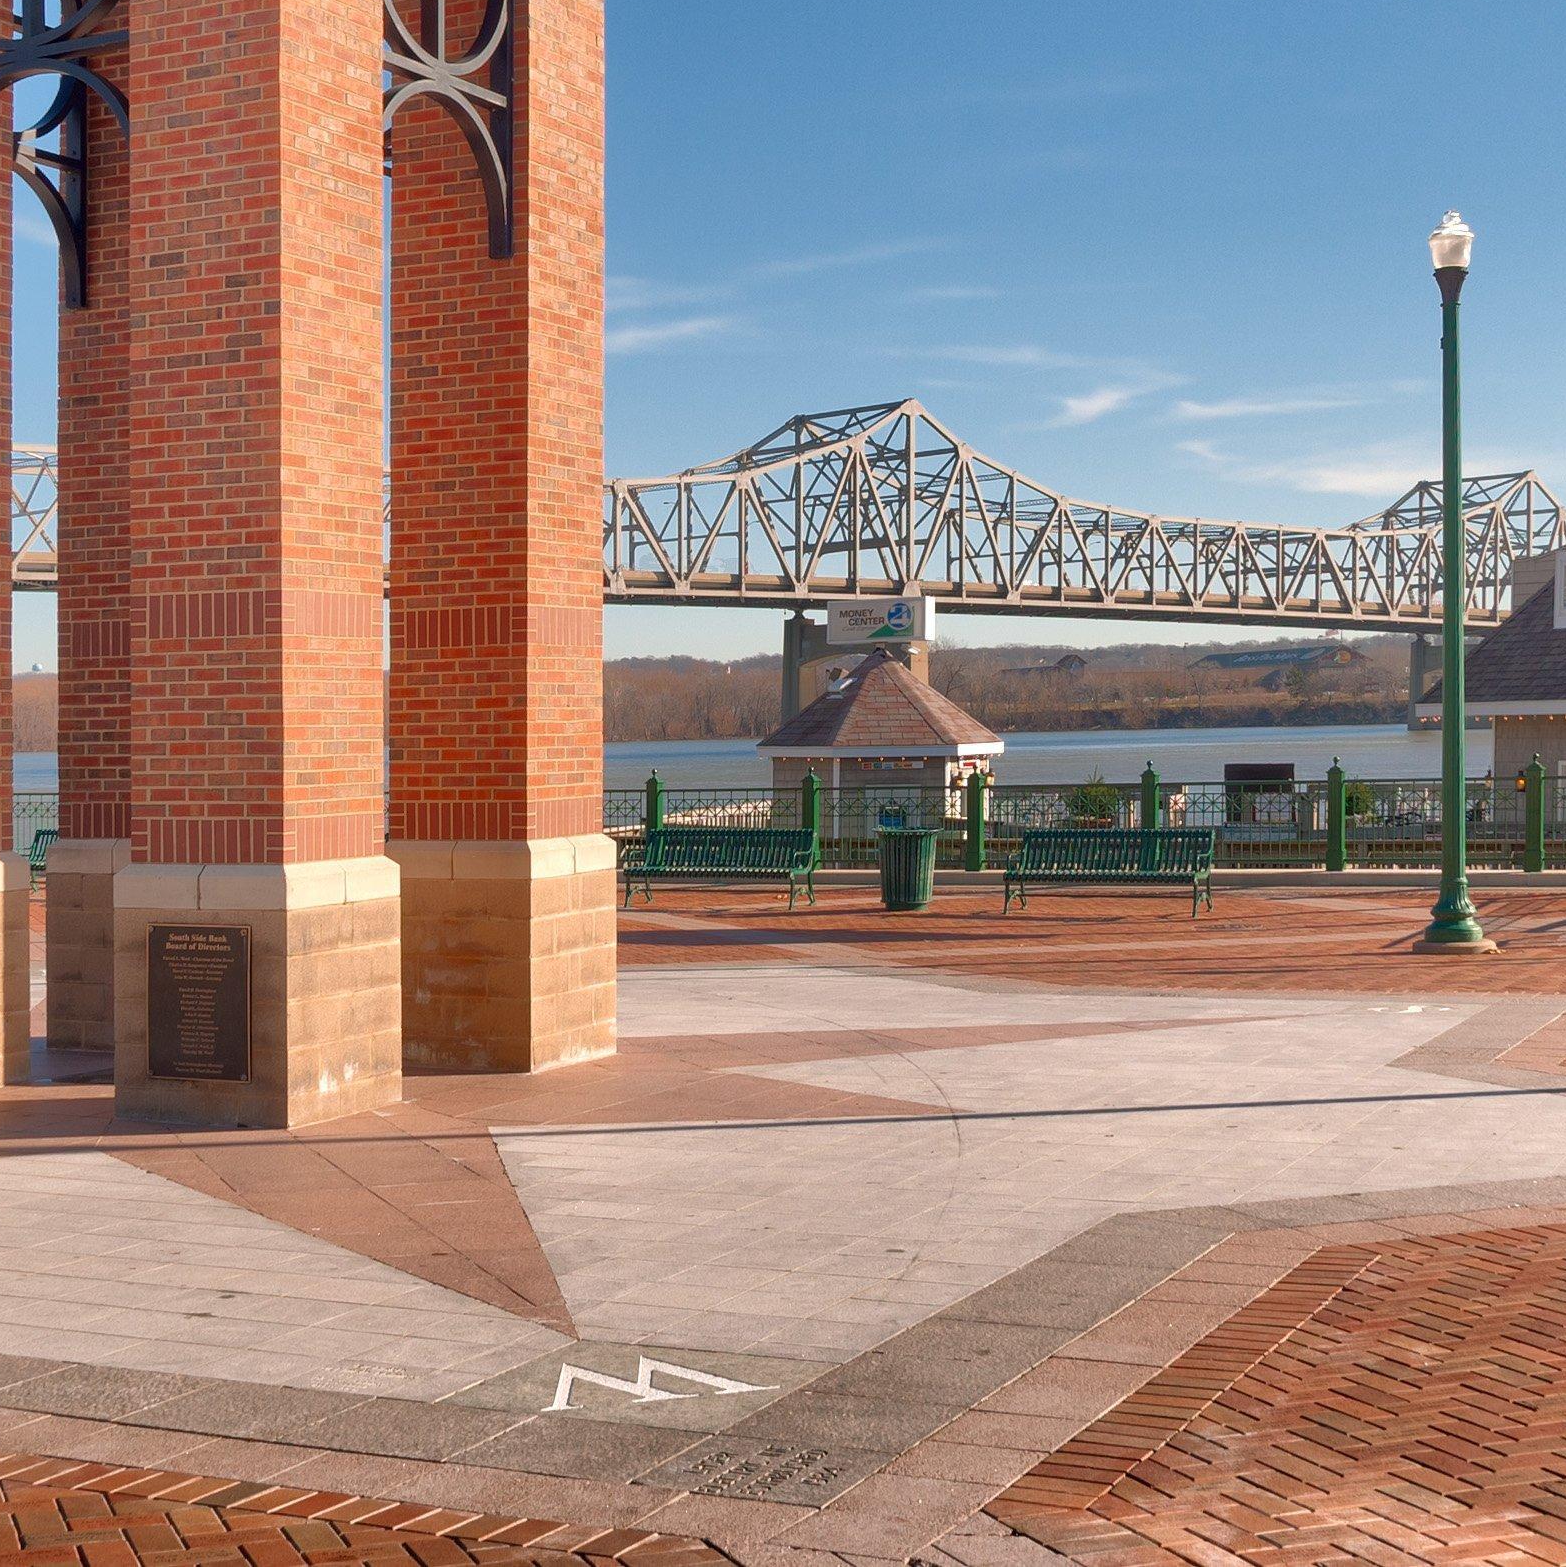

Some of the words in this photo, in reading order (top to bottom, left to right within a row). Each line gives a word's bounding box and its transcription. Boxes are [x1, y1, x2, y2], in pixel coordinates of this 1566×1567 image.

[839, 608, 874, 619] MONEY
[848, 617, 885, 627] CENTER
[168, 933, 190, 942] South
[191, 934, 207, 943] Side
[208, 935, 228, 943] Bank
[165, 942, 188, 950] Board
[197, 943, 231, 952] Directors
